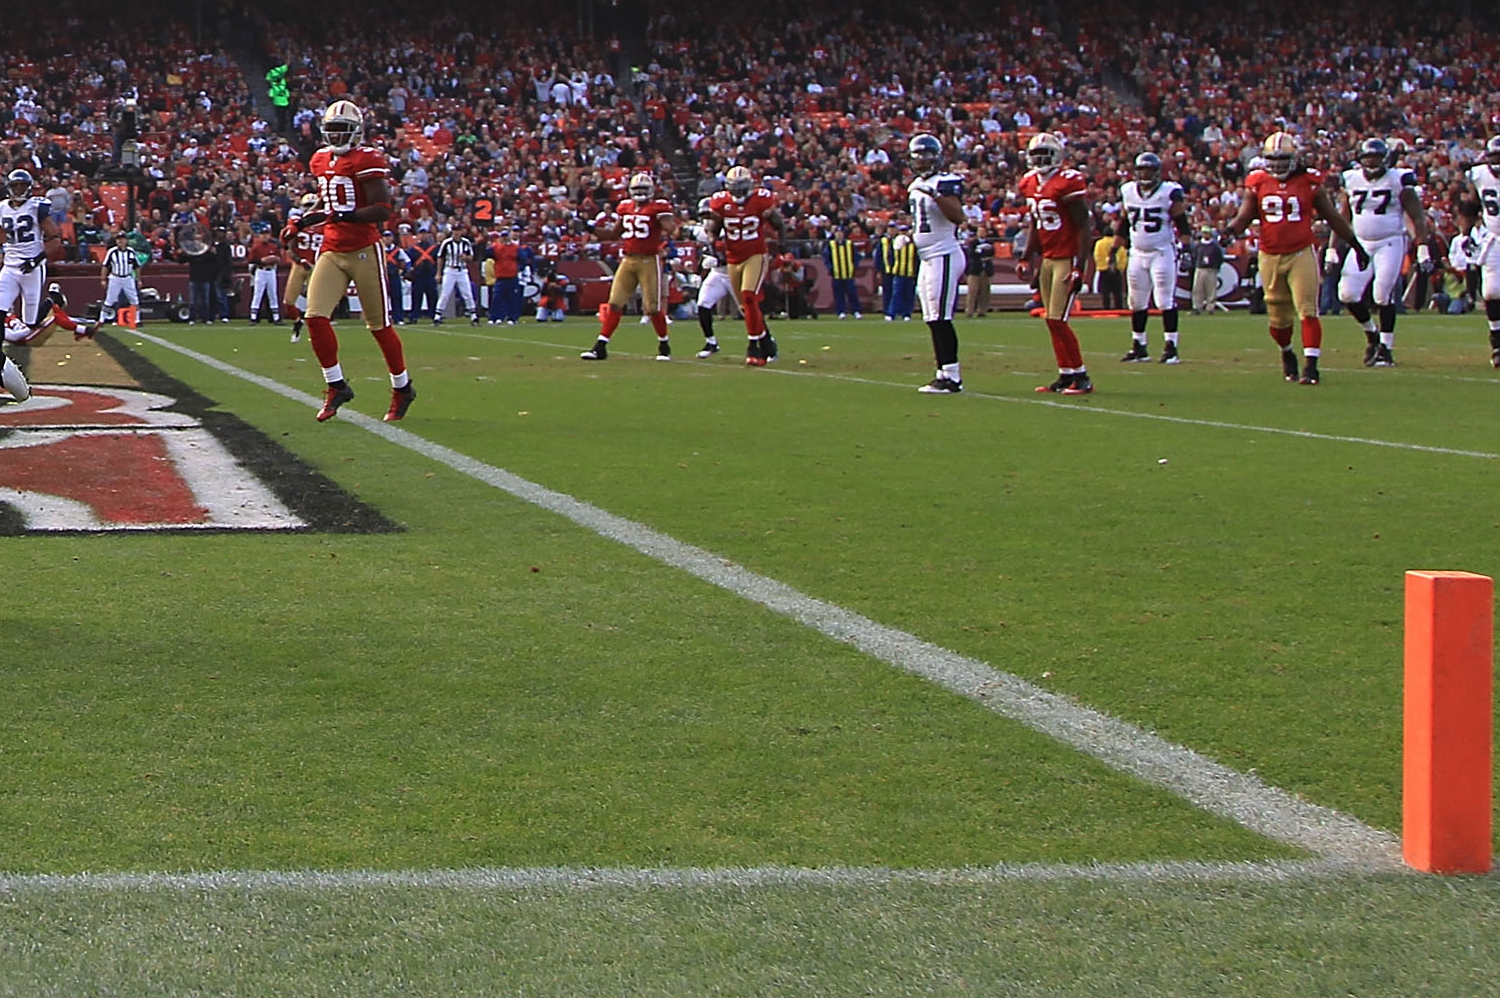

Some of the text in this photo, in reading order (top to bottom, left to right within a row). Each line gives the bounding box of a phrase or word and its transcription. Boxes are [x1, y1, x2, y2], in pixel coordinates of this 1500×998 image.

[474, 200, 493, 221] 2
[1261, 195, 1301, 223] 91
[1352, 189, 1392, 215] 77
[621, 215, 650, 240] 55
[723, 215, 760, 241] 52
[1128, 206, 1162, 233] 75
[230, 244, 246, 258] 10
[298, 232, 324, 251] 38
[538, 243, 559, 256] 12
